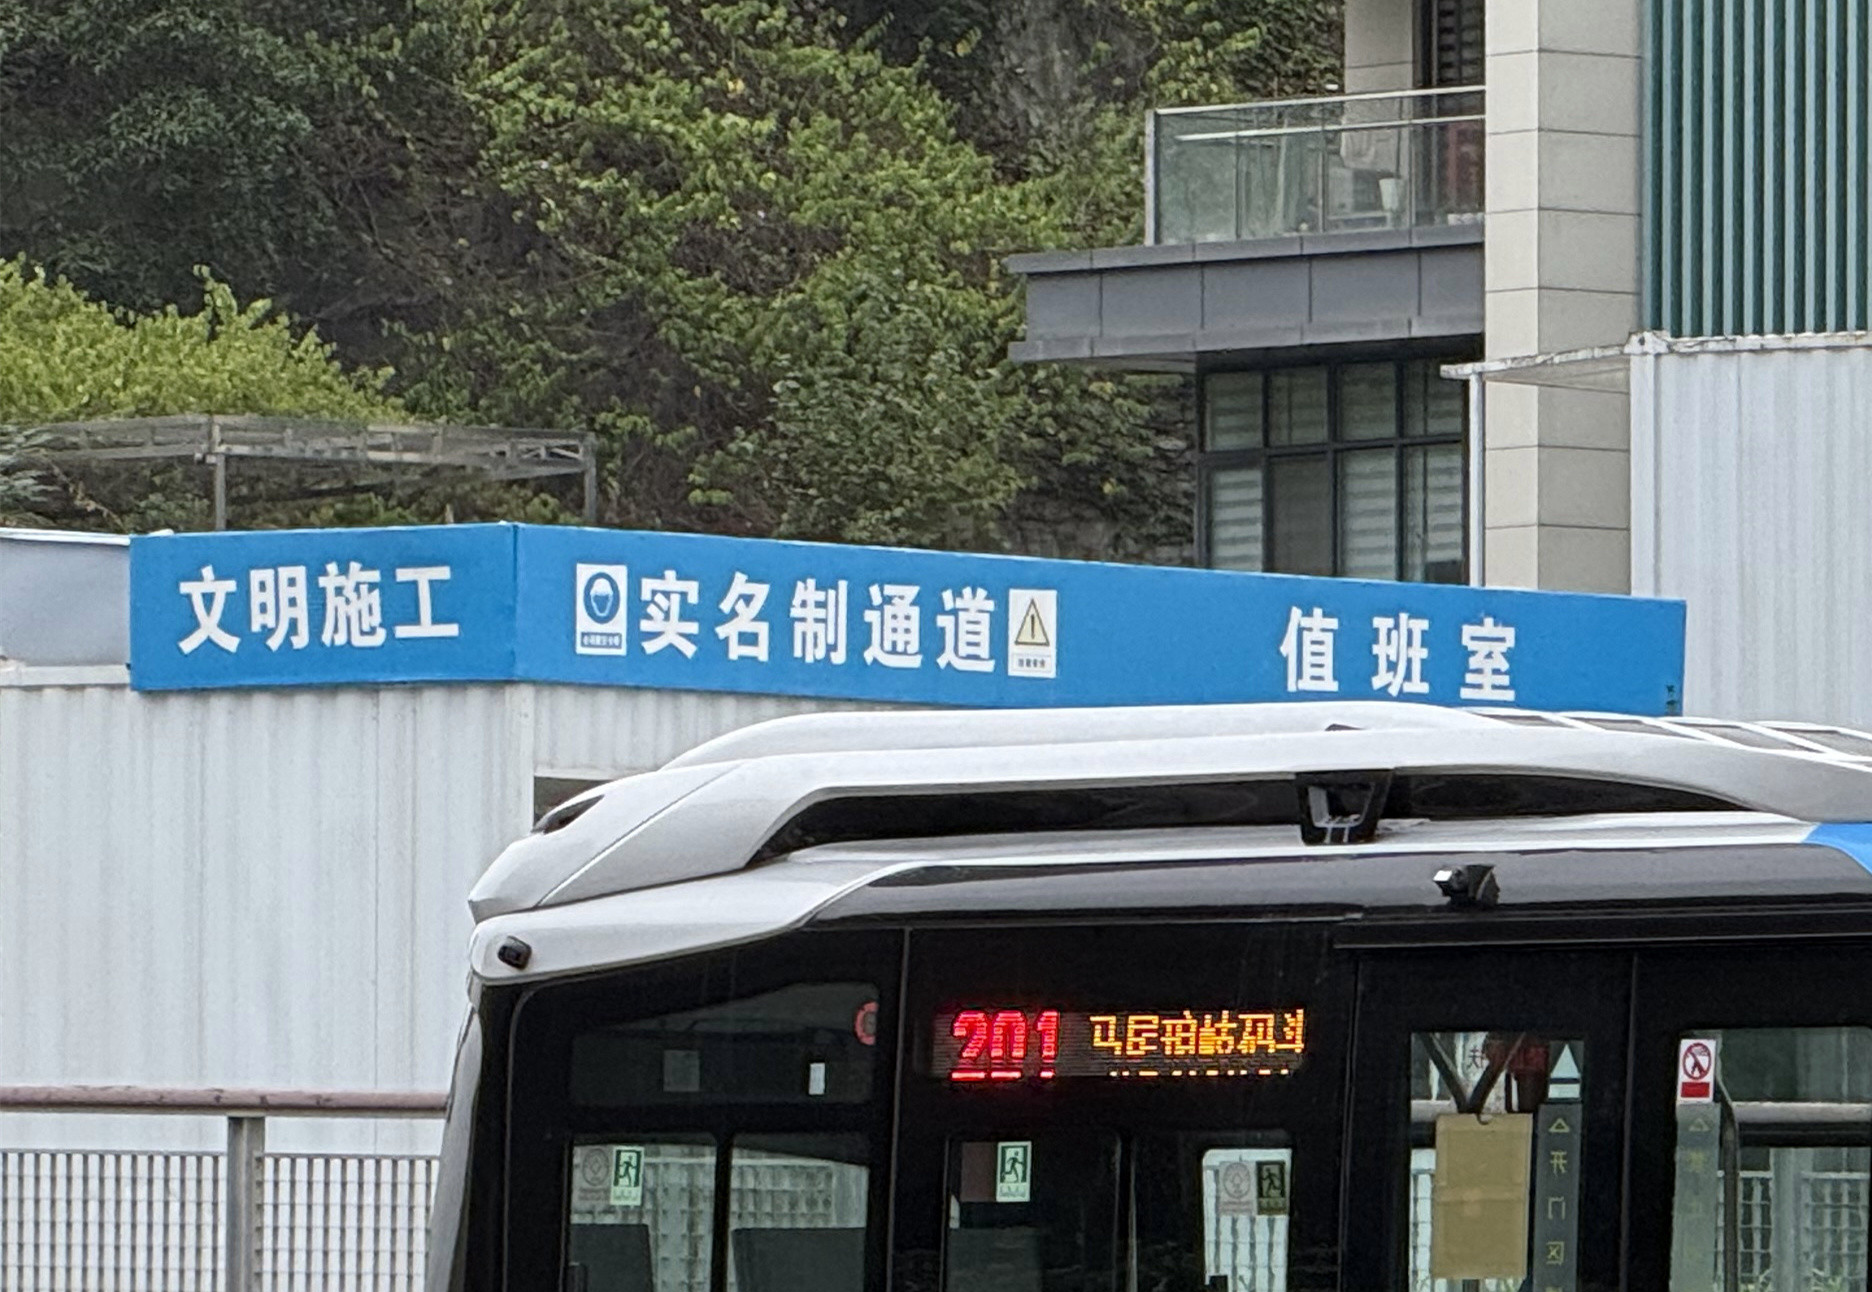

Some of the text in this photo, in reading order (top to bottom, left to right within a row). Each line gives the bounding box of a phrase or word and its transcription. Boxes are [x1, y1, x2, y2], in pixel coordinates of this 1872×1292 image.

[178, 561, 460, 655] 文明施工
[639, 570, 996, 672] 实名制通道
[1280, 605, 1517, 701] 值班室
[951, 1009, 1060, 1080] 201
